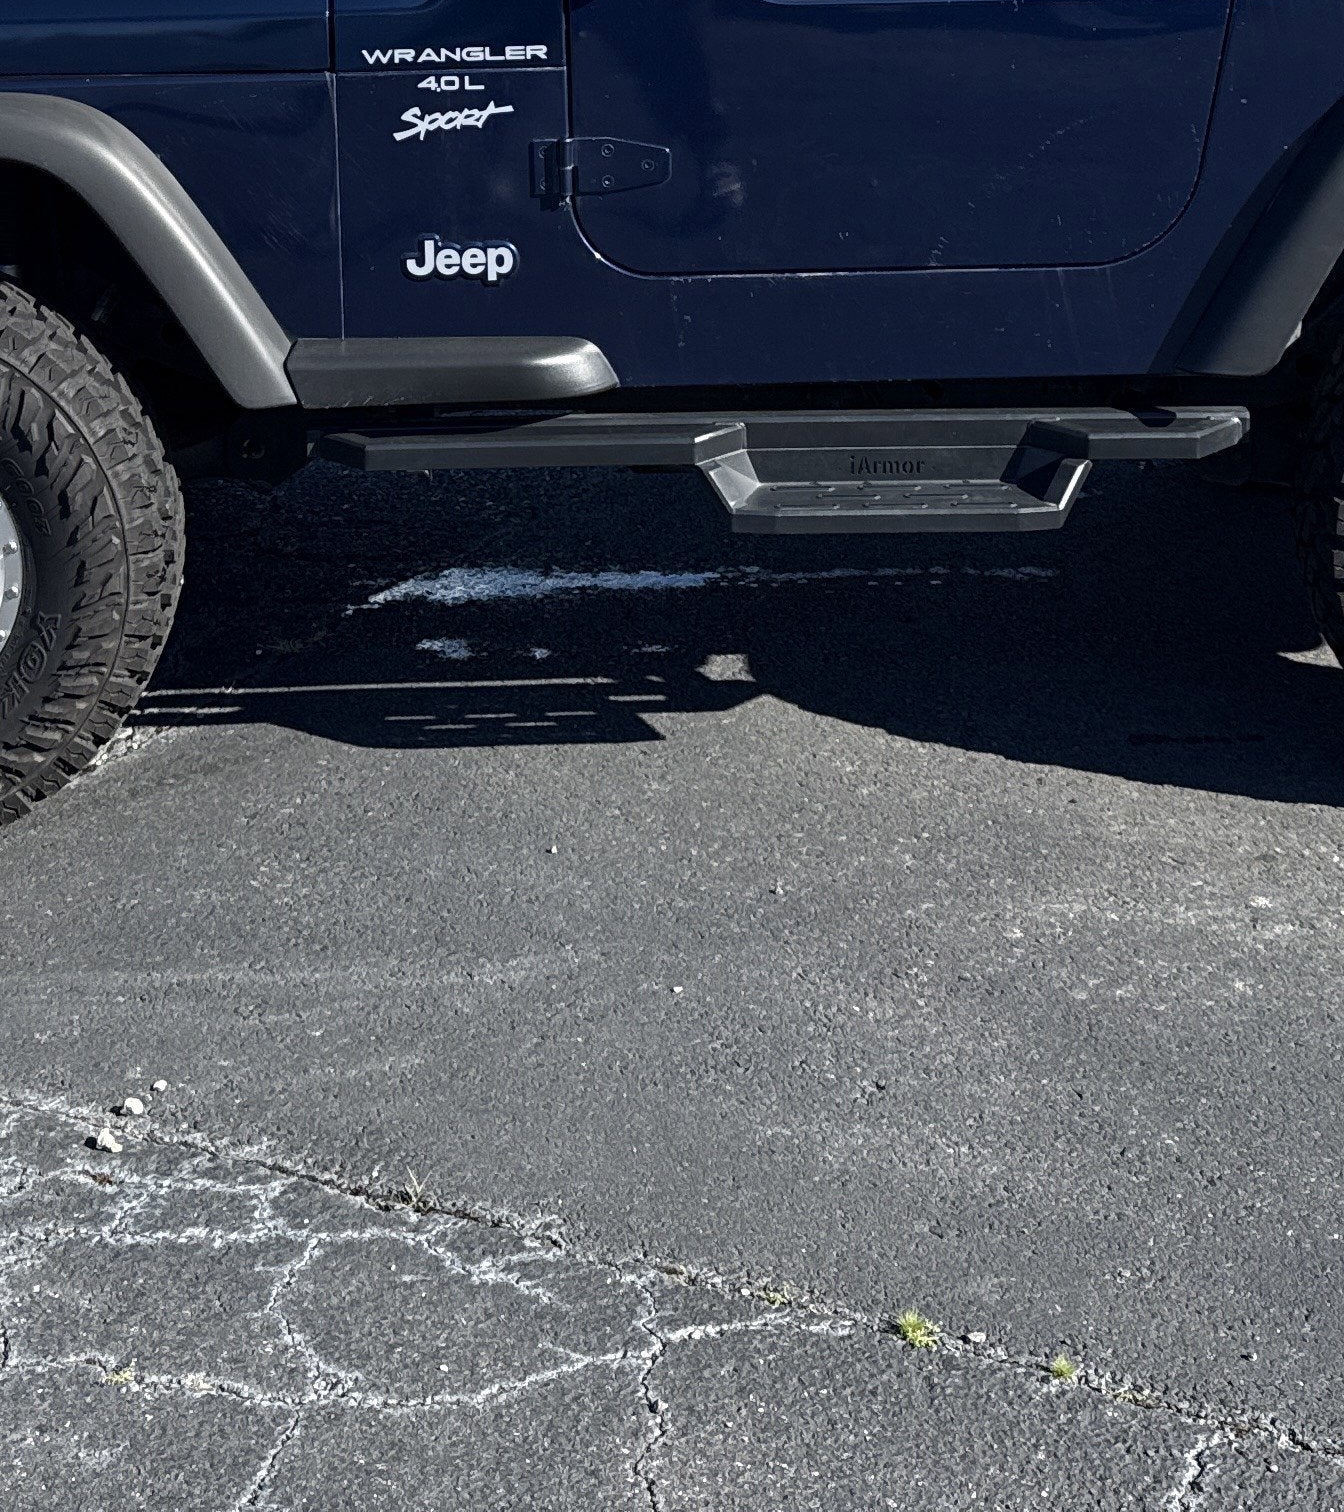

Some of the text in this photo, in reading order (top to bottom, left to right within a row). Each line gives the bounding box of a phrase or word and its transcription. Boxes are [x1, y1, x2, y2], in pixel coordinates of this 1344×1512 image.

[361, 44, 548, 65] WRANGLER
[405, 239, 514, 281] Jeep
[849, 455, 926, 475] iArmor
